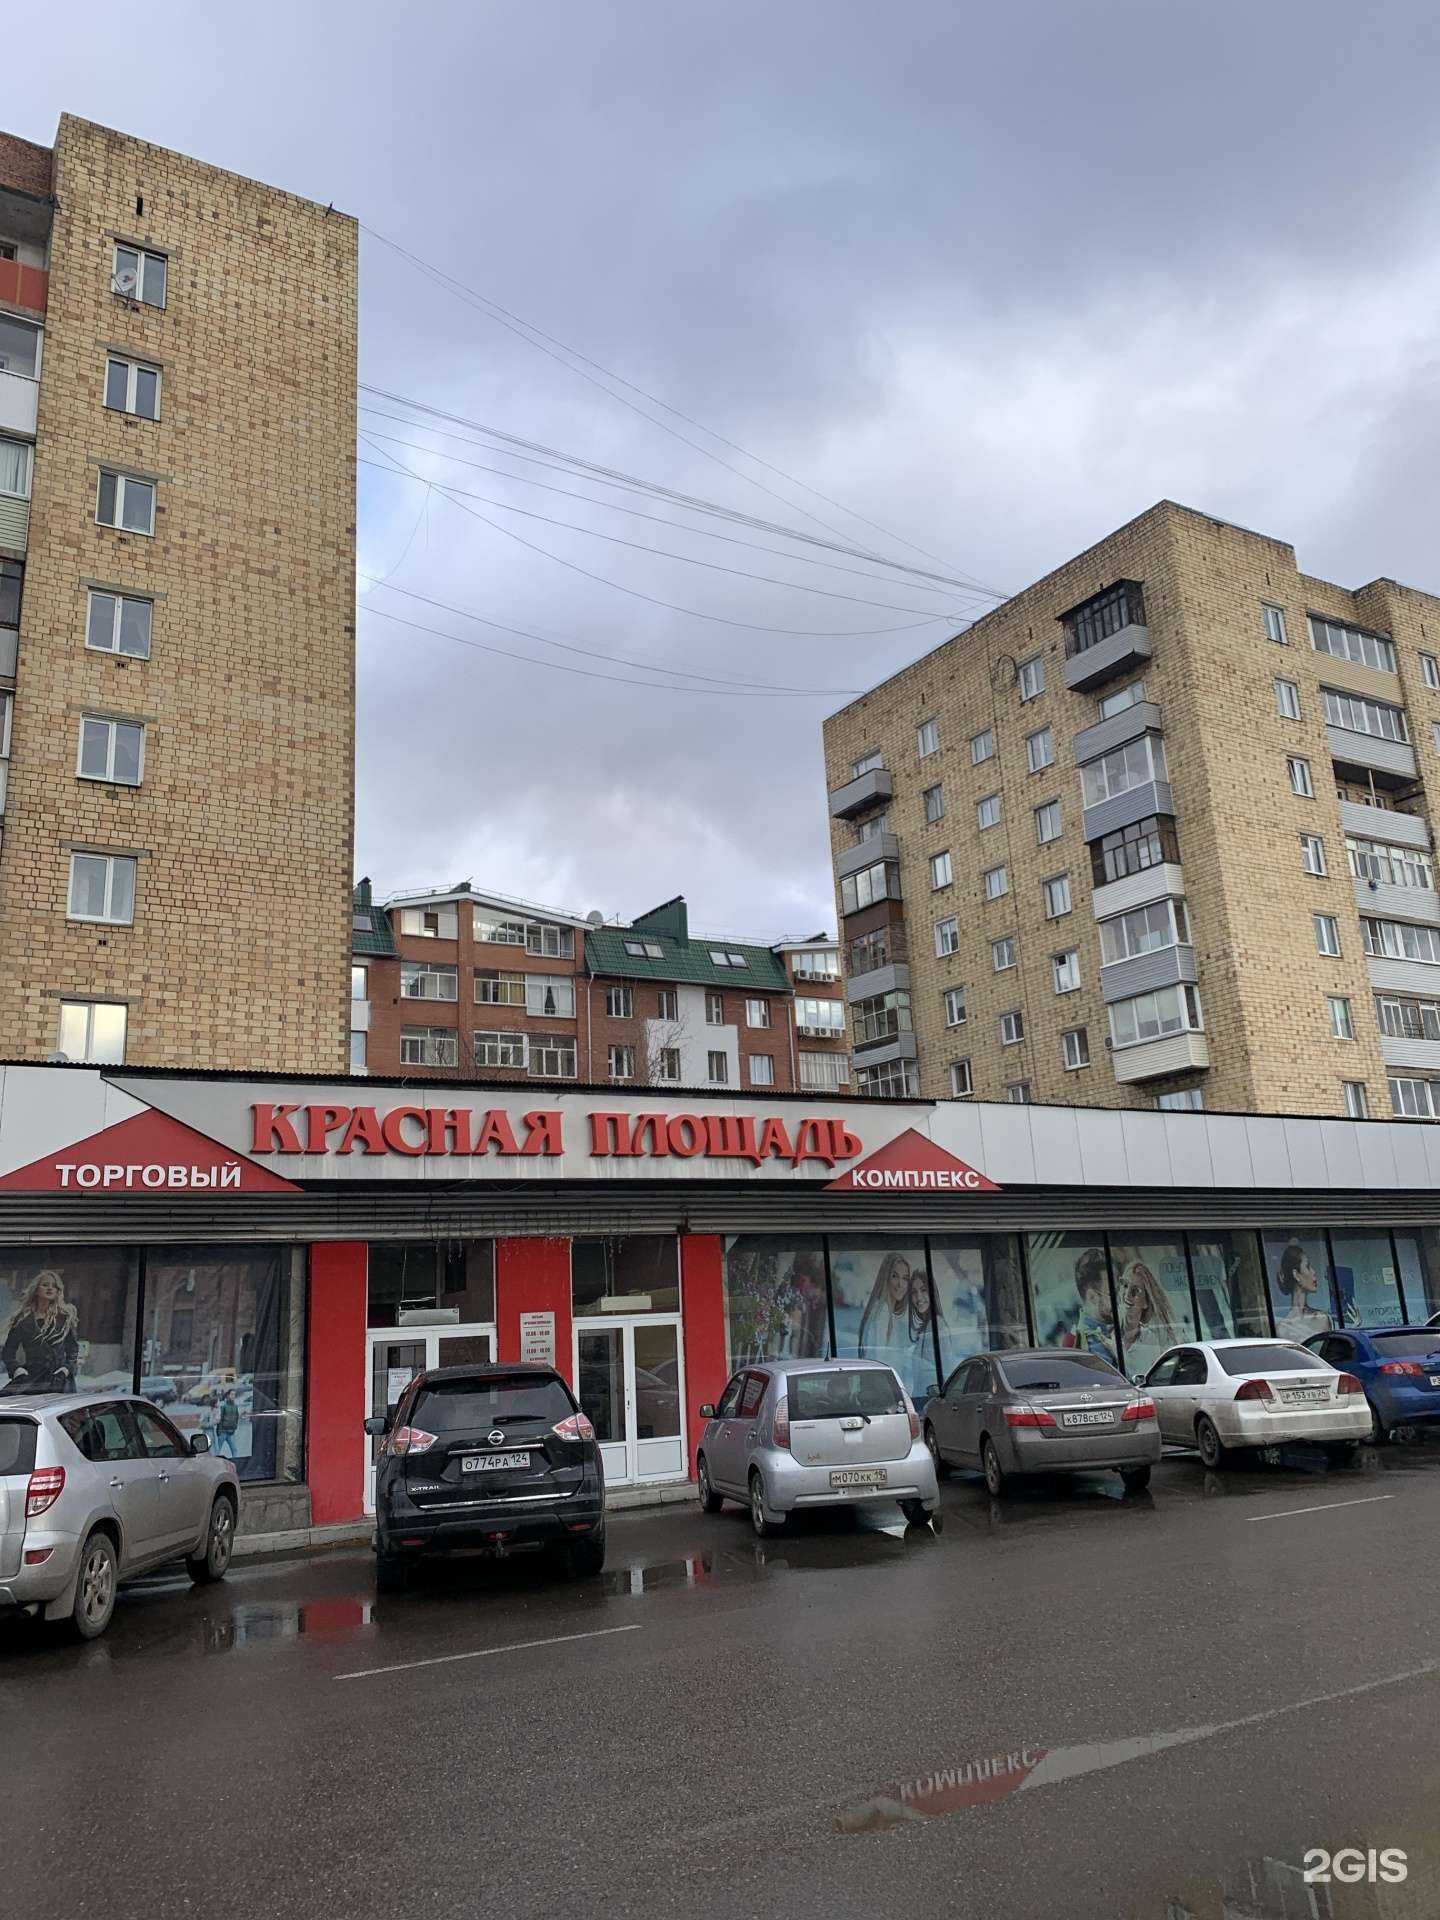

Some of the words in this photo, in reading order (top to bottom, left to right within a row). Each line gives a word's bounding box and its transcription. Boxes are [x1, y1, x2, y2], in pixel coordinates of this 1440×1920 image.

[249, 1103, 565, 1156] КРАСНАЯ
[587, 1112, 863, 1169] ПЛОЩАДЬ
[56, 1161, 241, 1188] ТОРГОВЫЙ
[852, 1169, 980, 1188] КОМПЛЕКС
[465, 1457, 509, 1470] О774РА
[511, 1453, 528, 1463] 124
